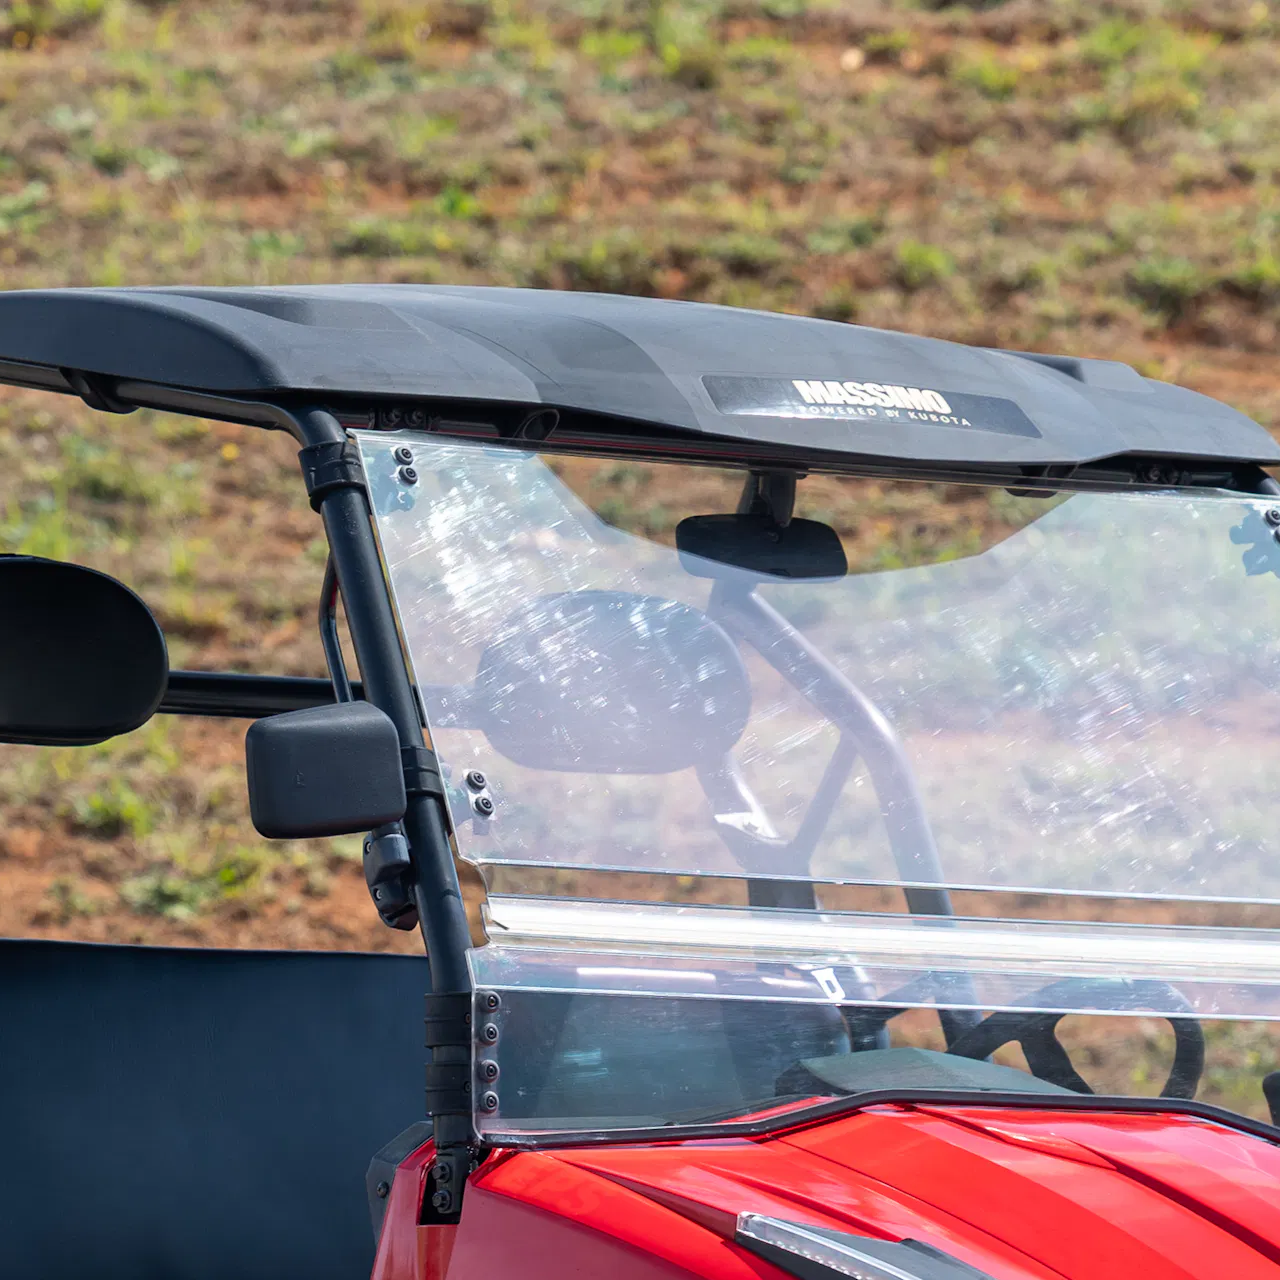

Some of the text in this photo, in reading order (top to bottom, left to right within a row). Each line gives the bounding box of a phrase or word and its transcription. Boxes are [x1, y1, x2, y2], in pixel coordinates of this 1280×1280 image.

[791, 379, 952, 415] MASSIMO
[798, 404, 972, 427] POWERED BY KUBOTA
